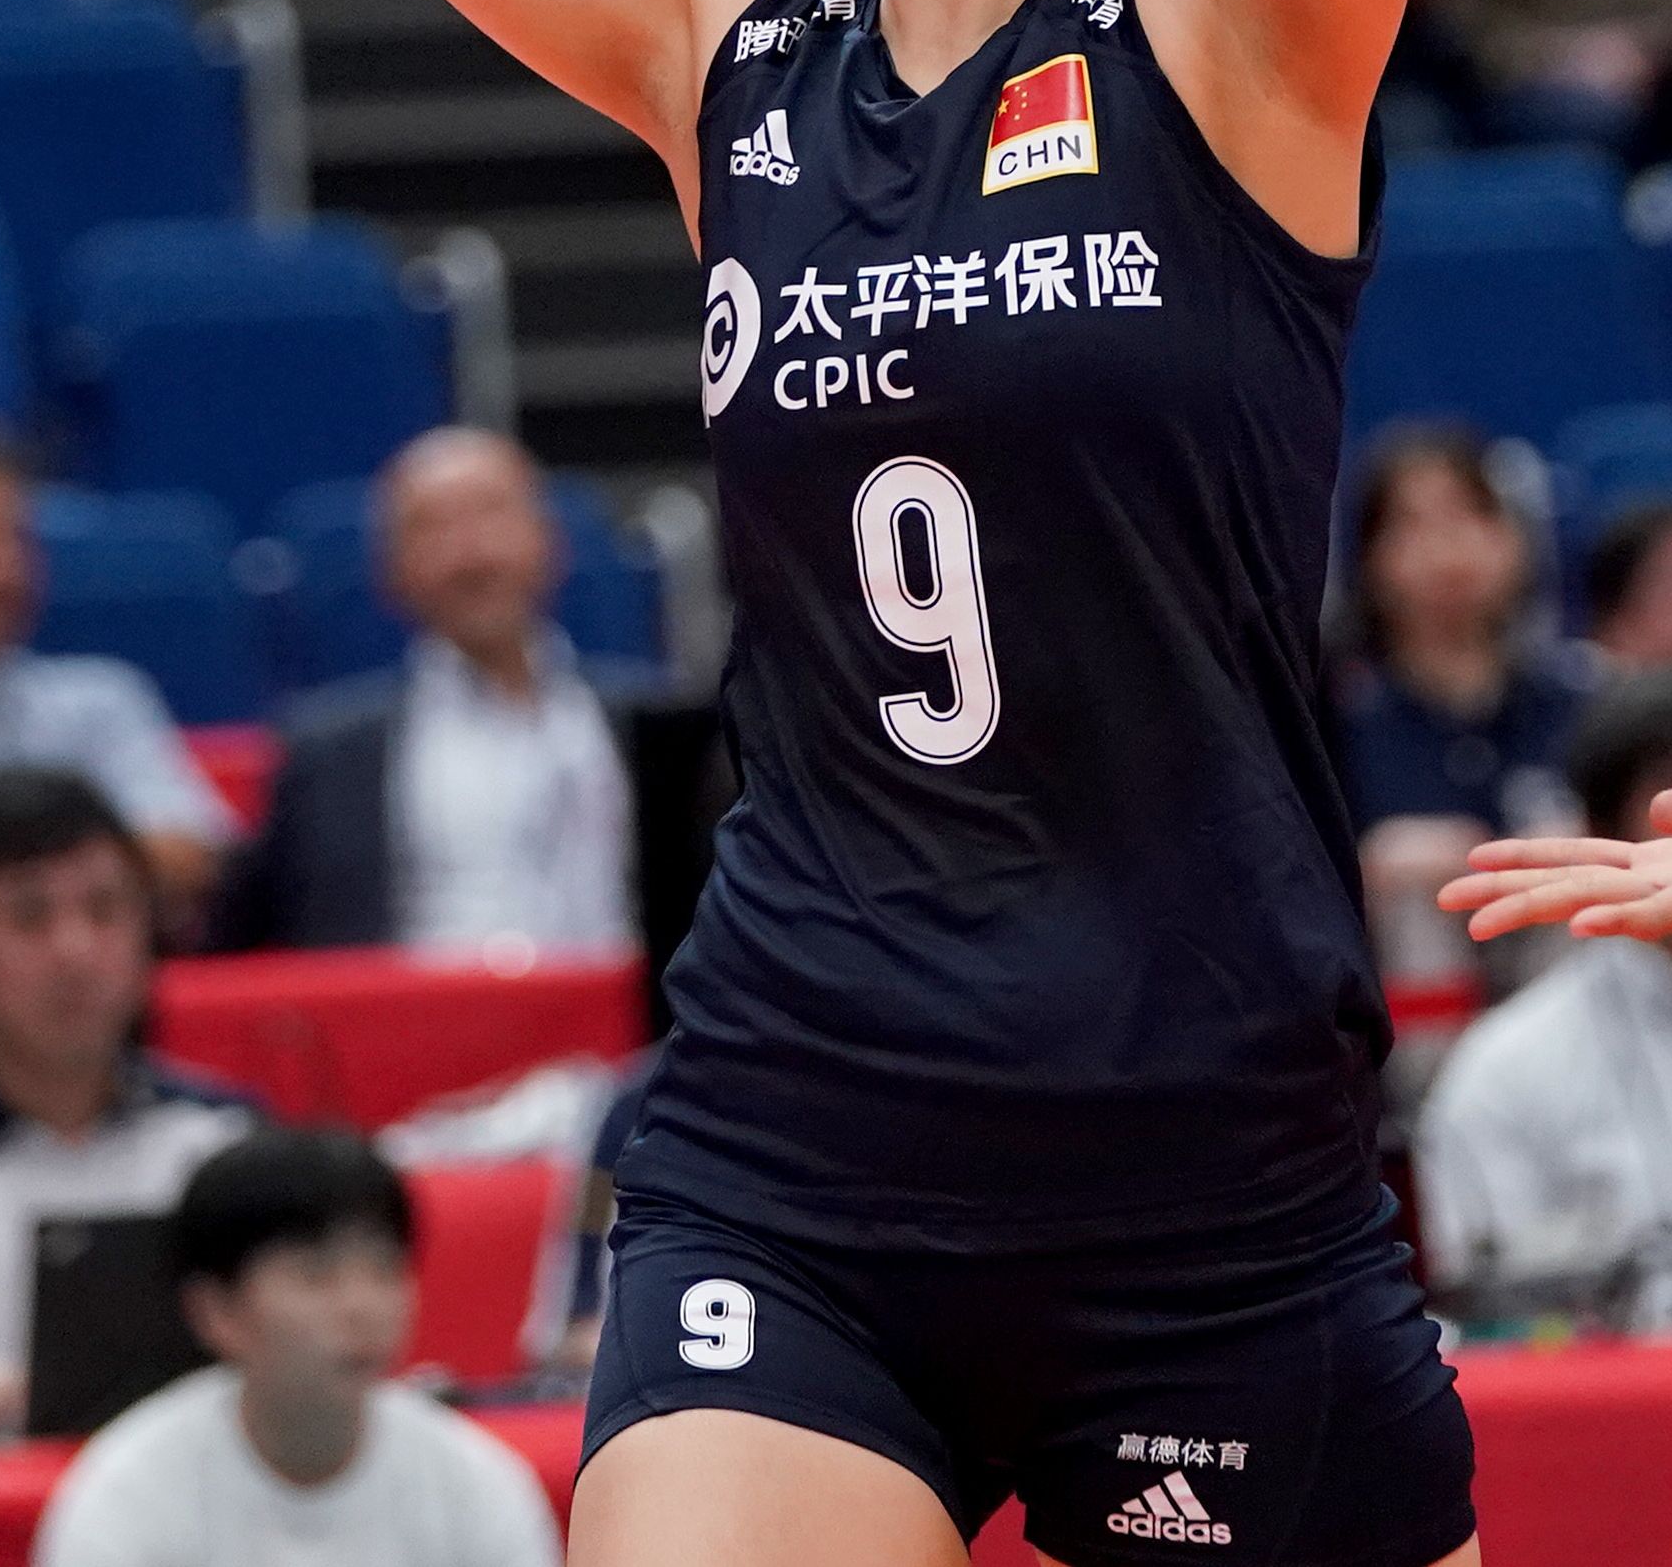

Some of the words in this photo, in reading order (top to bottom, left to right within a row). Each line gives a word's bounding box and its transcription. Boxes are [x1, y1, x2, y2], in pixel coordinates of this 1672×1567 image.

[998, 135, 1082, 176] CHN
[774, 230, 1163, 344] 太平洋保险
[773, 349, 915, 410] CPIC
[852, 455, 1001, 766] 9
[678, 1278, 756, 1371] 9
[1107, 1512, 1233, 1545] adidas
